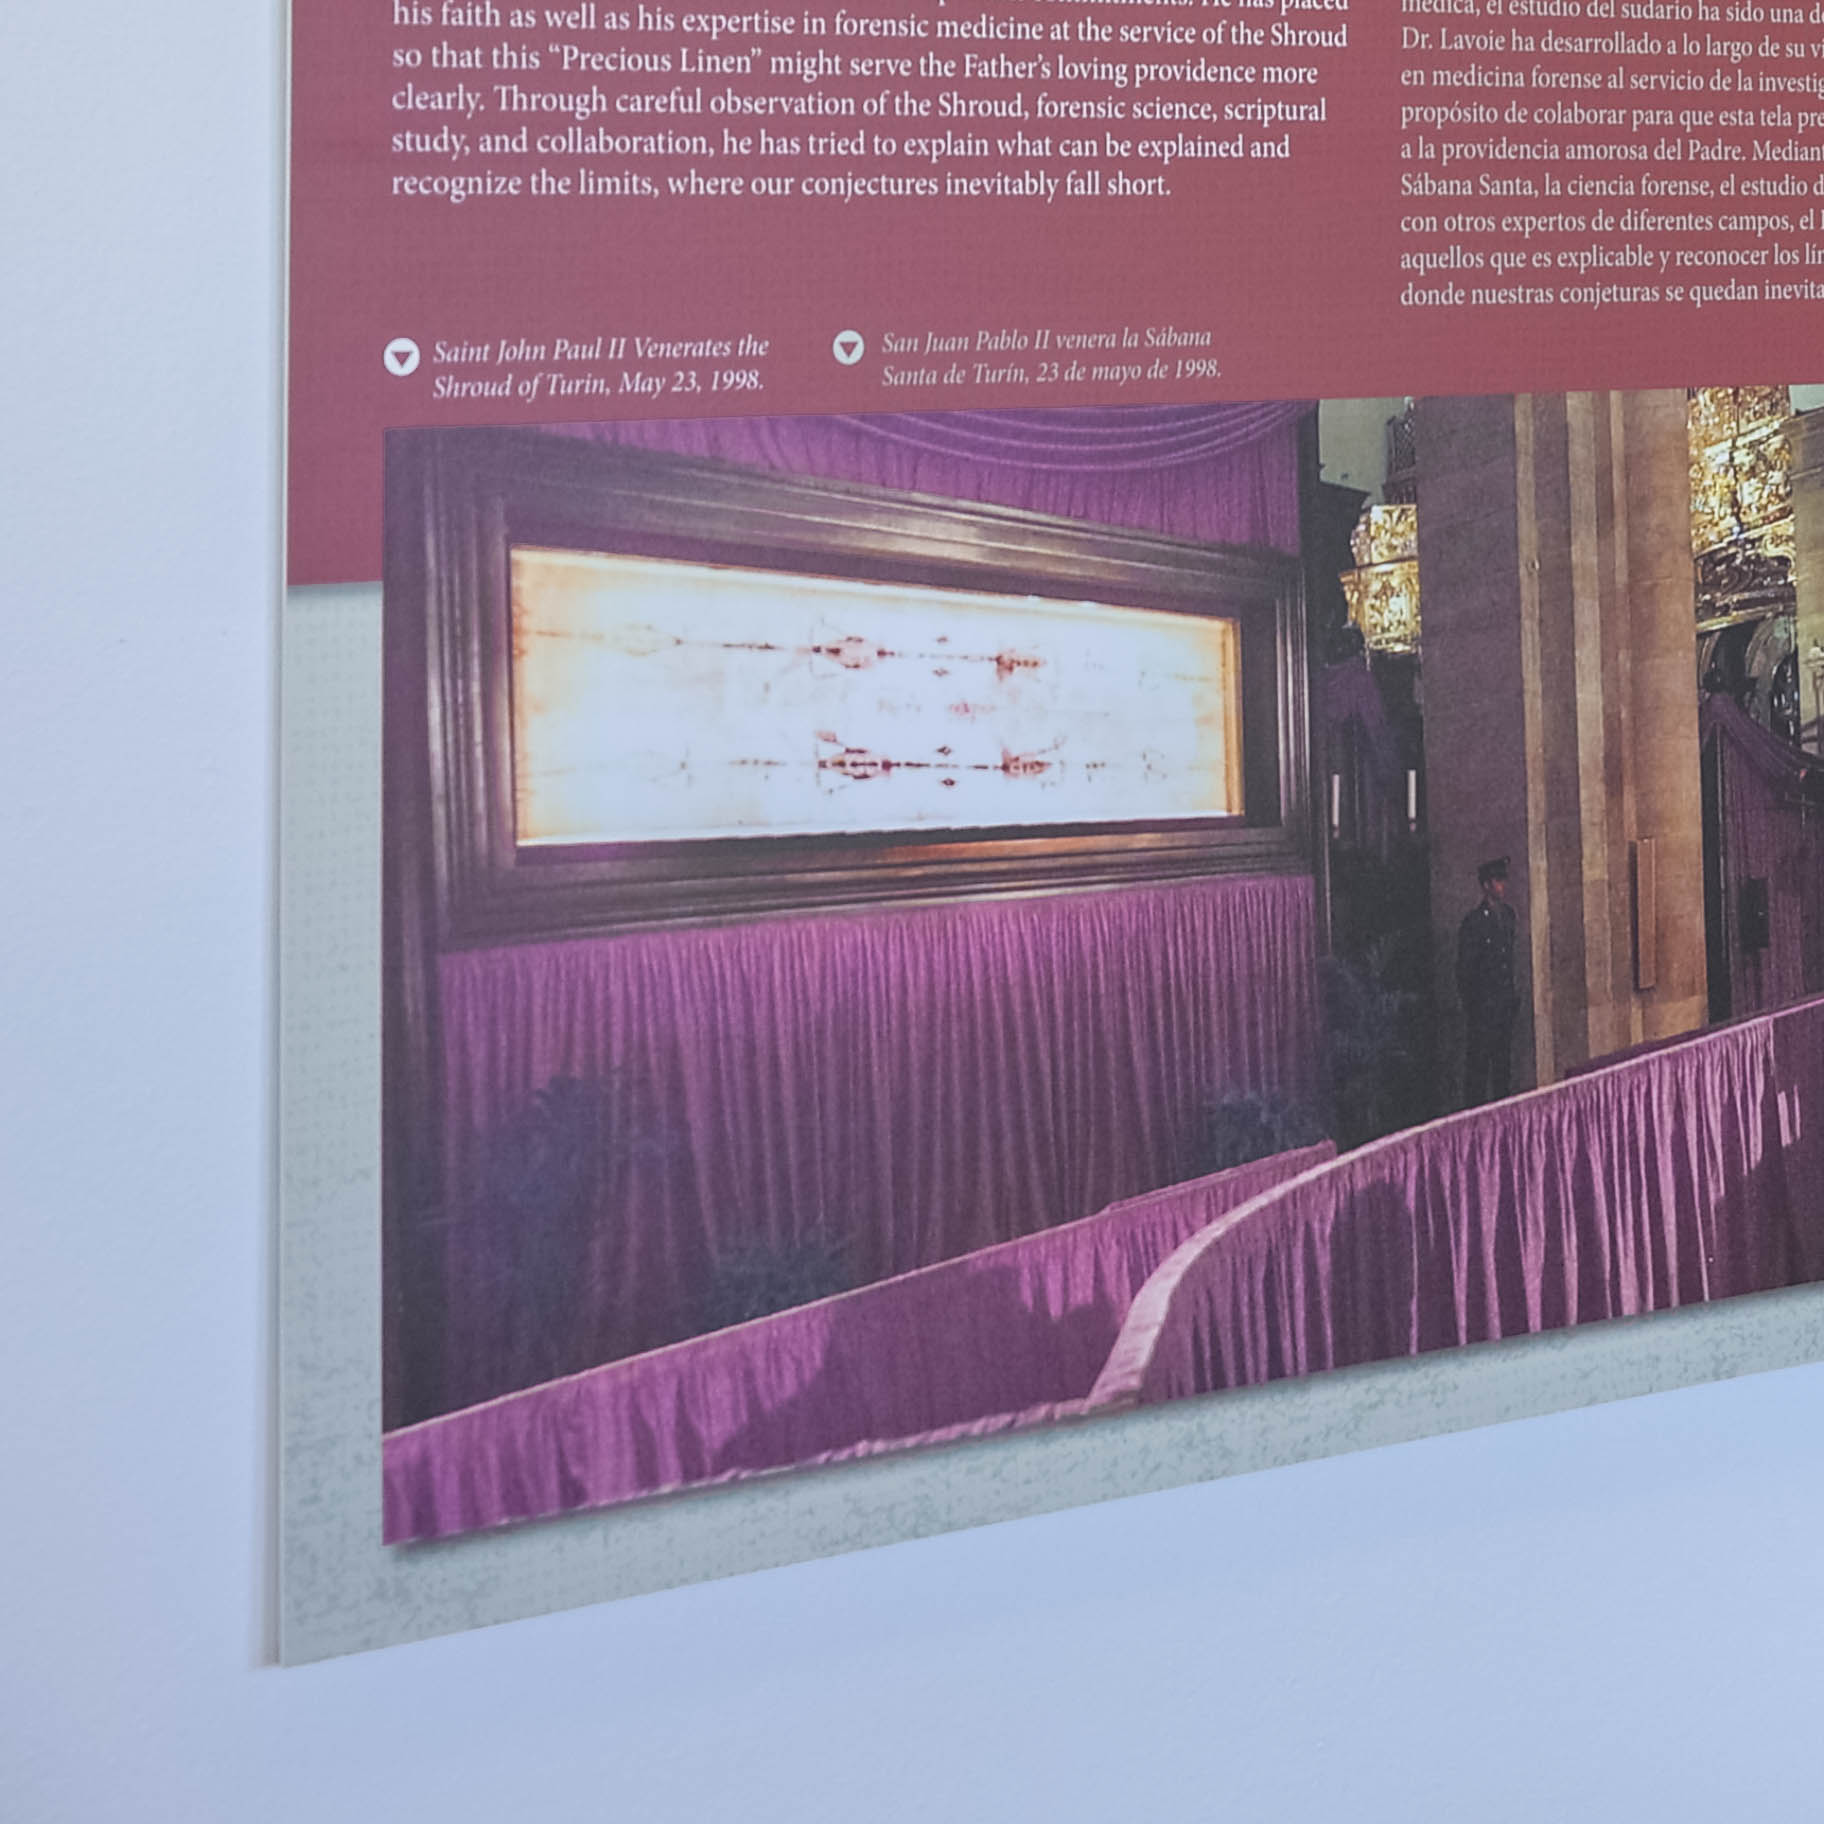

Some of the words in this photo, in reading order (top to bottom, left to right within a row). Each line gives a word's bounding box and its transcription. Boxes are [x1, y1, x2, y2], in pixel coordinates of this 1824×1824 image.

[432, 339, 491, 364] Saint
[495, 337, 547, 366] John
[552, 335, 603, 362] Paul
[608, 336, 628, 361] II
[634, 335, 733, 360] Venerates
[737, 332, 771, 358] the
[880, 331, 920, 354] San
[923, 330, 970, 356] Juan
[975, 327, 1029, 352] Pablo
[1033, 328, 1052, 351] II
[1055, 332, 1118, 350] venera
[1121, 326, 1140, 350] la
[1143, 324, 1212, 349] Sábana
[431, 372, 514, 399] Shroud
[517, 371, 544, 403] of
[546, 372, 612, 397] Turin,
[617, 370, 668, 401] May
[671, 369, 704, 395] 23,
[710, 368, 766, 394] 1998.
[881, 364, 938, 387] Santa
[942, 361, 967, 386] de
[972, 362, 1030, 386] Turín,
[1035, 361, 1060, 384] 23
[1063, 359, 1087, 383] de
[1091, 364, 1143, 388] mayo
[1145, 356, 1170, 380] de
[1174, 357, 1222, 380] 1998.
